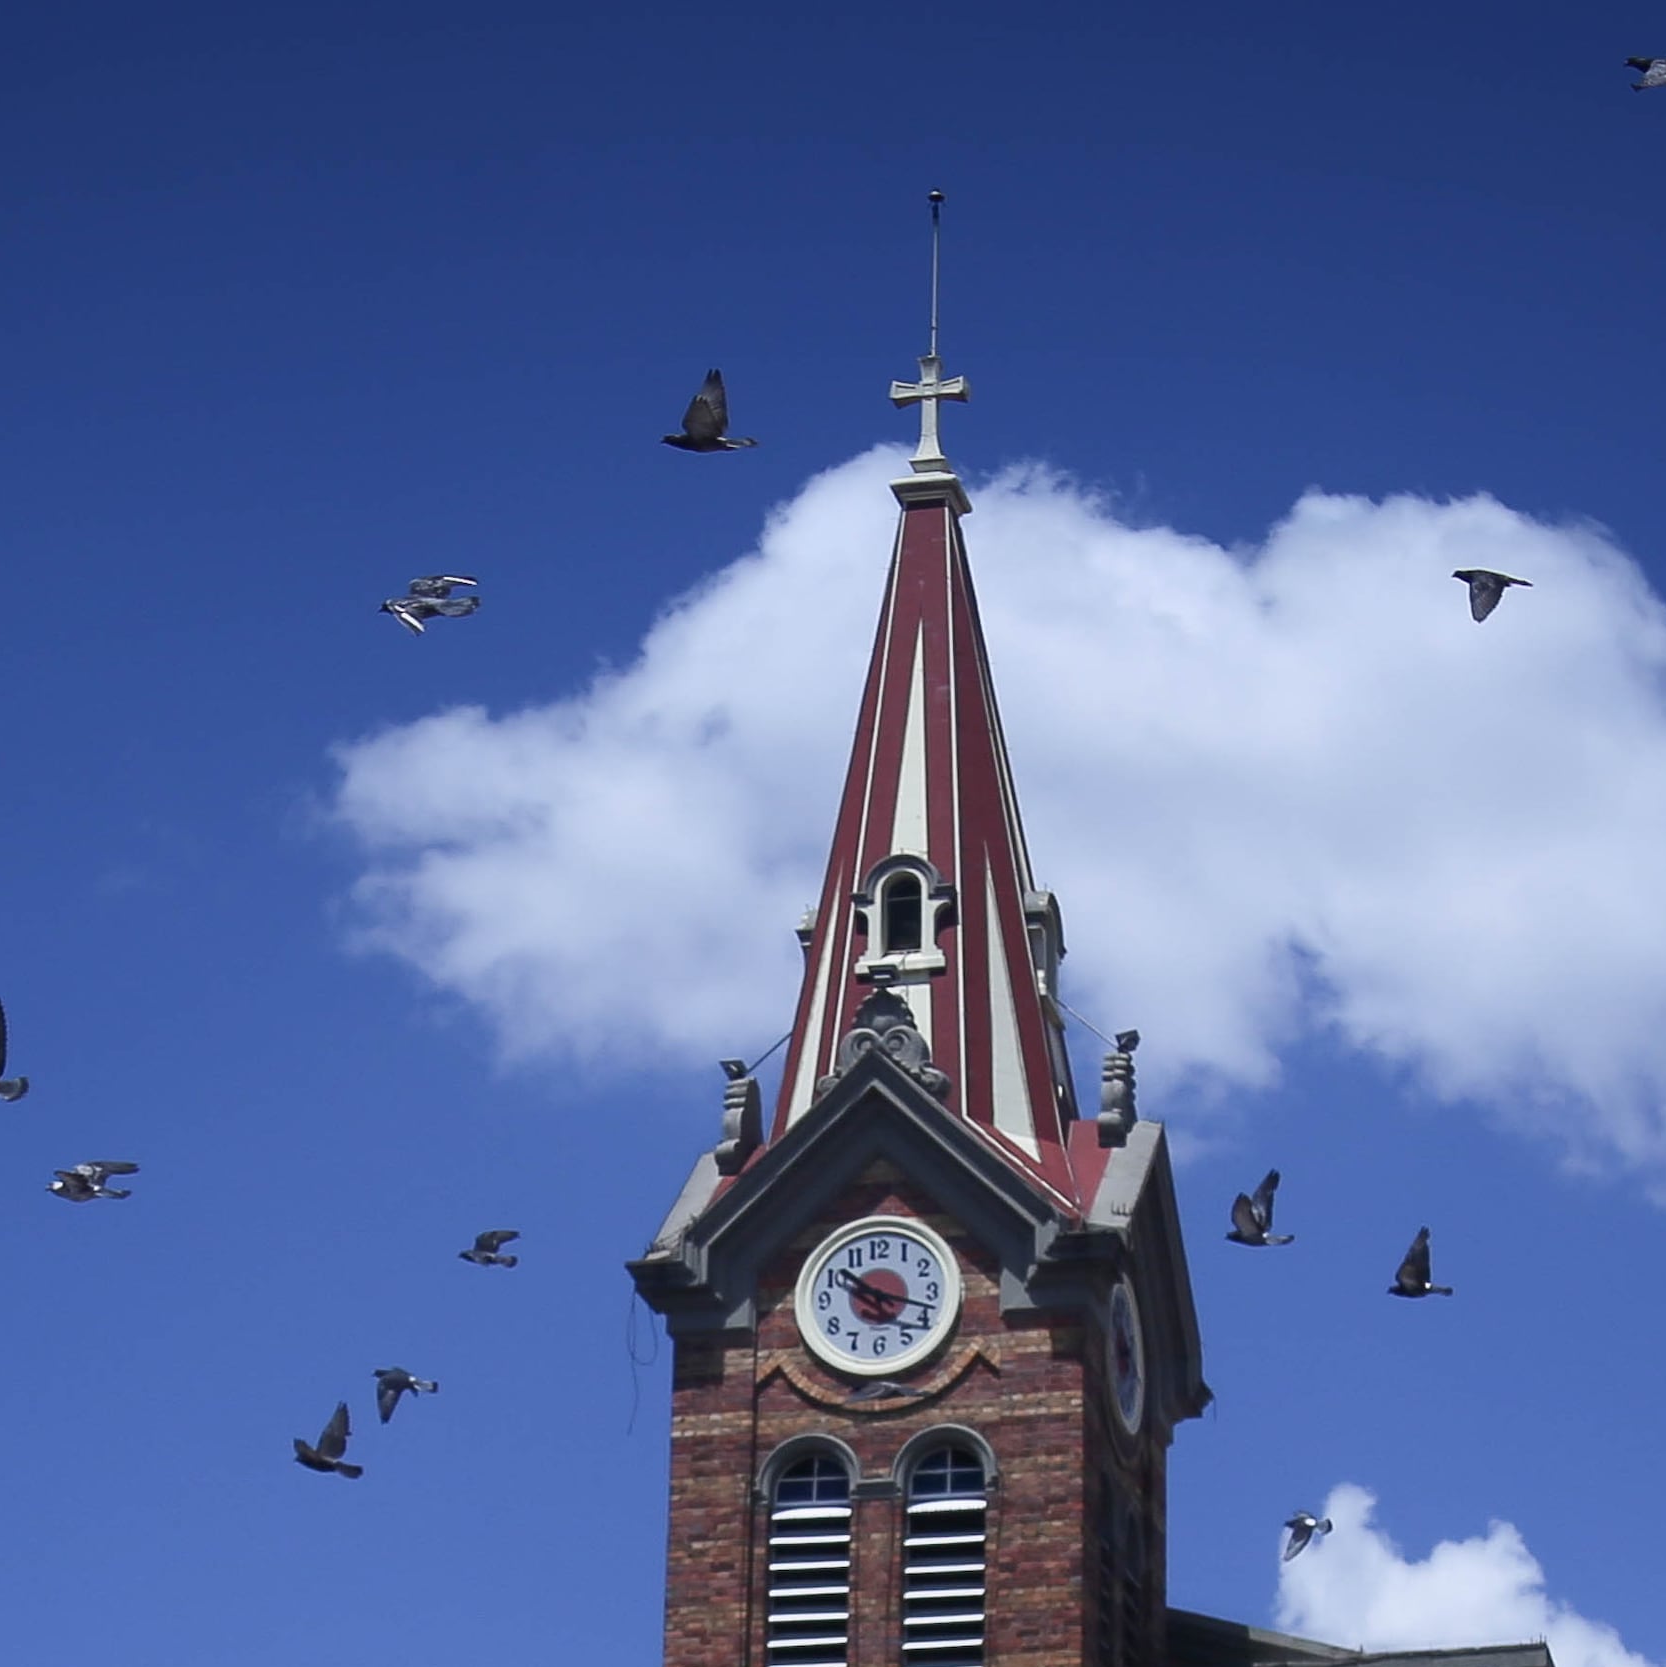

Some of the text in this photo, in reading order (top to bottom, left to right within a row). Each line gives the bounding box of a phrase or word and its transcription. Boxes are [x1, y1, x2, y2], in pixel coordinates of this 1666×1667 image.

[848, 1247, 862, 1268] 11
[870, 1239, 889, 1260] 12
[901, 1242, 907, 1262] 1
[917, 1258, 930, 1277] 2
[827, 1268, 847, 1289] 10
[818, 1291, 831, 1310] 9
[926, 1281, 938, 1301] 3
[827, 1316, 840, 1335] 8
[917, 1306, 929, 1328] 4
[846, 1331, 859, 1351] 7
[900, 1323, 913, 1345] 5
[873, 1335, 886, 1355] 6
